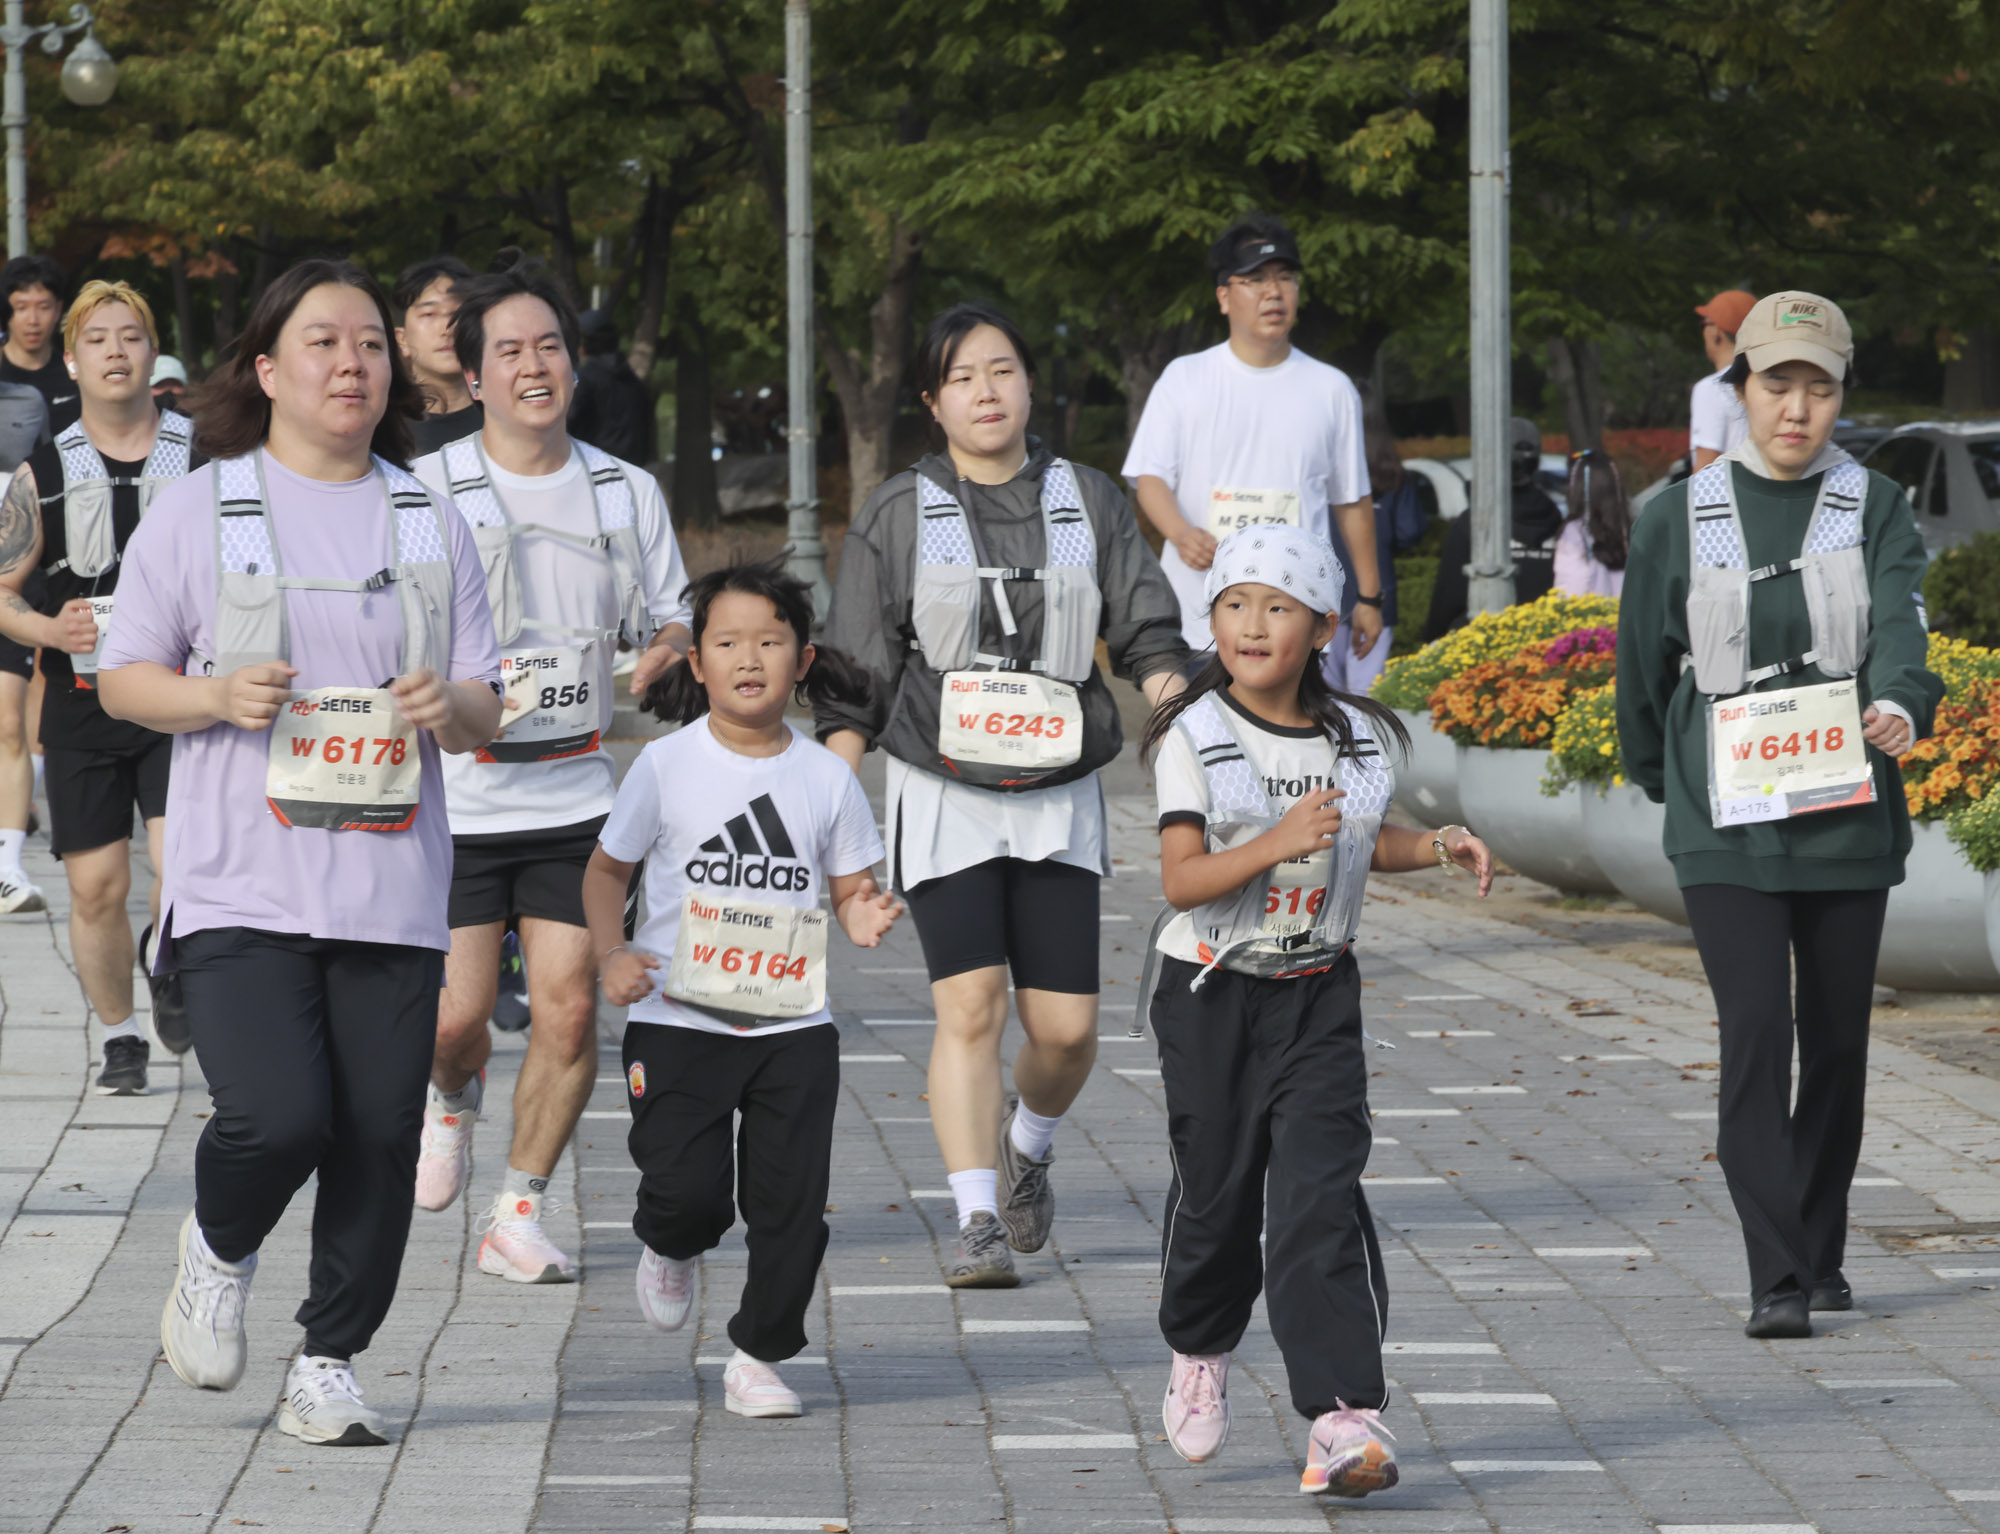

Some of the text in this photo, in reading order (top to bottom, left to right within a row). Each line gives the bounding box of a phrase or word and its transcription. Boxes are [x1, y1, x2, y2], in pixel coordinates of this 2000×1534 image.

[1790, 303, 1818, 315] NIKE
[1218, 516, 1232, 526] M
[539, 681, 590, 710] 856
[951, 679, 979, 693] Run
[1828, 688, 1850, 698] 5km
[959, 712, 1065, 739] W 6243
[1719, 706, 1747, 724] Run
[291, 735, 406, 766] W 6178
[1731, 726, 1845, 761] W 6418
[1729, 802, 1772, 817] A-175
[685, 853, 811, 892] adidas
[690, 898, 719, 921] Run
[693, 943, 807, 981] W 6164
